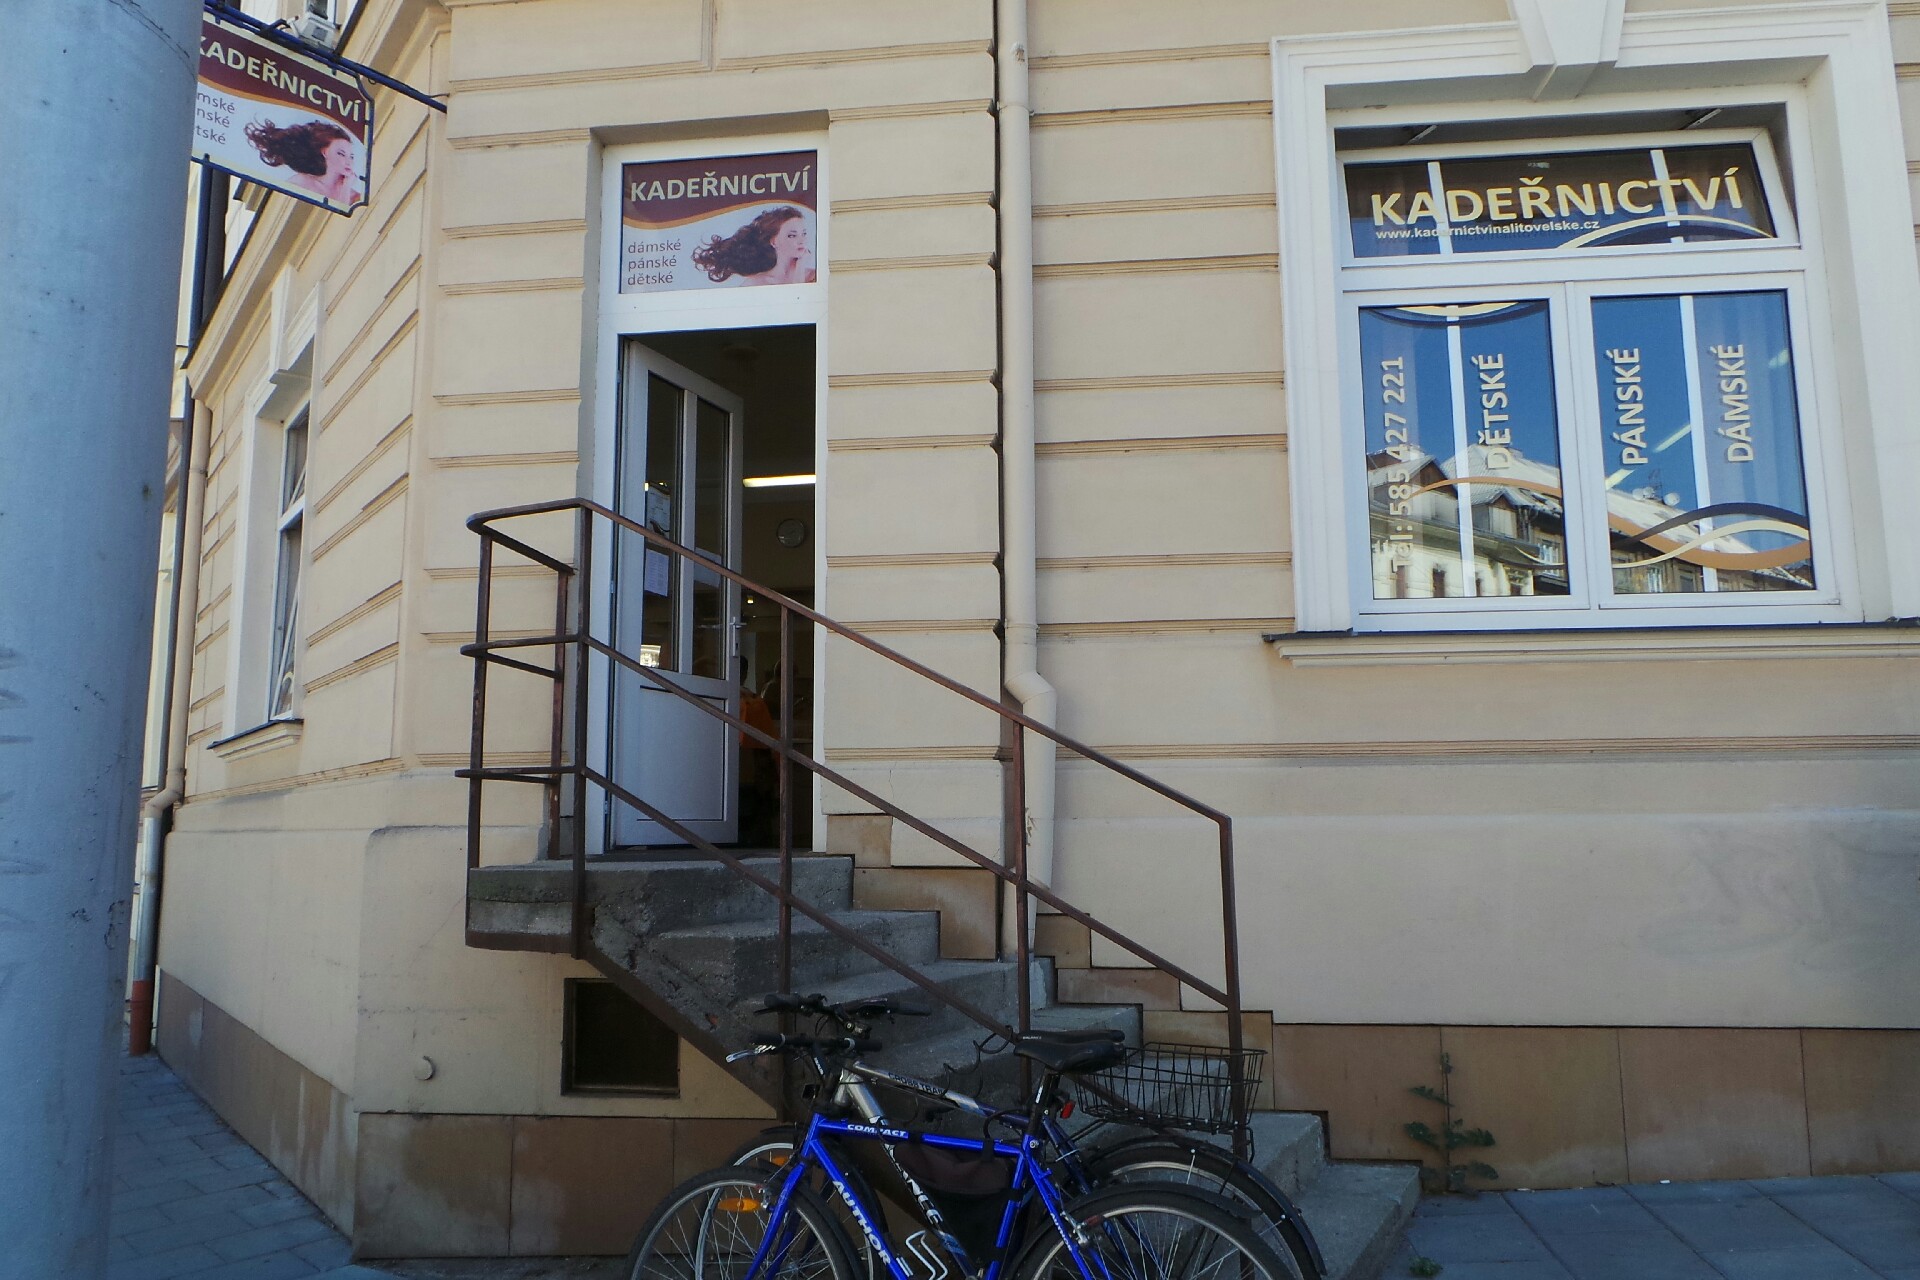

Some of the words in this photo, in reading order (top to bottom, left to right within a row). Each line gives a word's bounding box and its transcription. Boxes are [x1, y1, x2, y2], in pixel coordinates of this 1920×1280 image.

[197, 92, 236, 114] mské
[197, 107, 230, 128] nské
[196, 125, 226, 145] tské
[631, 165, 811, 202] KADEŘNICTVÍ
[1371, 166, 1742, 226] KADEŘNICTVÍ
[628, 239, 682, 254] dámské
[628, 255, 677, 272] pánské
[628, 271, 674, 286] dětské
[1381, 356, 1405, 403] 221
[1471, 352, 1510, 470] DĚTSKÉ
[1605, 347, 1649, 465] PÁNSKÉ
[1709, 344, 1754, 463] DÁMSKÉ
[1384, 412, 1408, 460] 427
[1388, 470, 1412, 515] 585
[832, 1180, 892, 1266] AUTHOR
